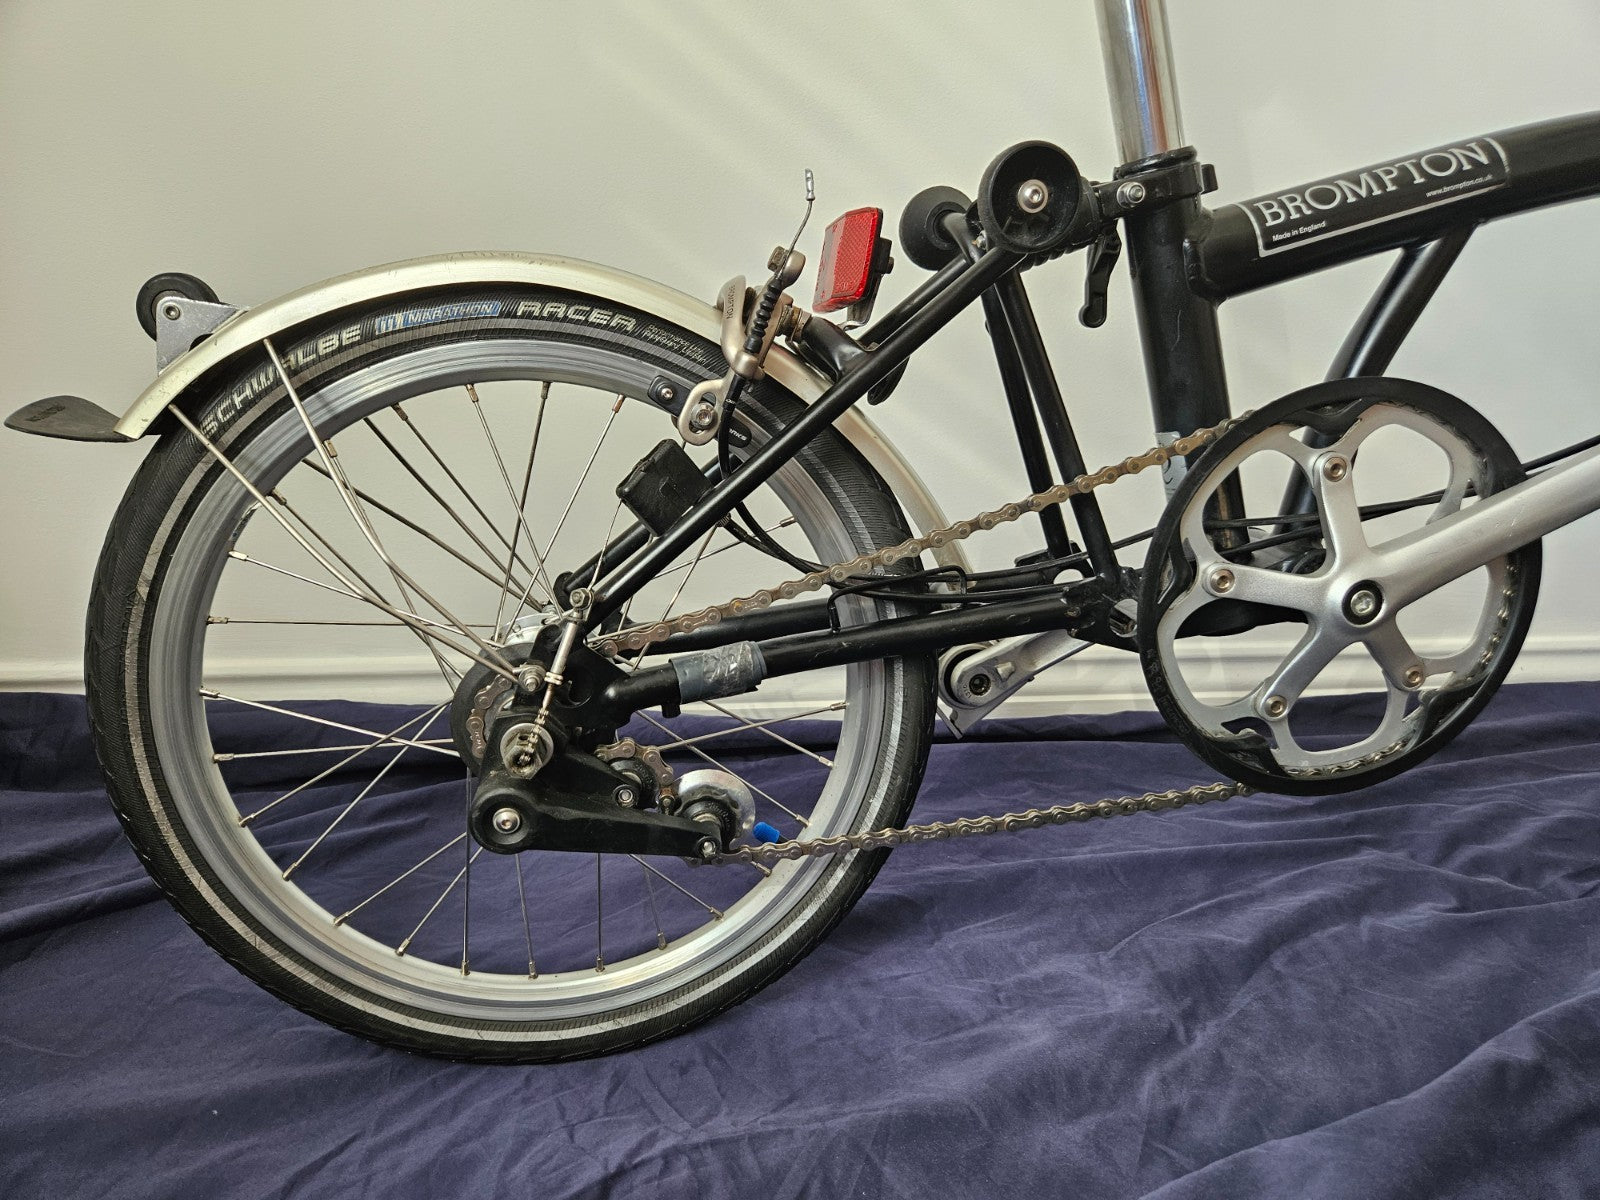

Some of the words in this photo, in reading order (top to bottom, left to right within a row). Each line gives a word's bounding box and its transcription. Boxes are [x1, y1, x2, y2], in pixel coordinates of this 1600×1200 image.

[1254, 141, 1490, 227] BROMPTON
[1272, 232, 1291, 242] Made
[1299, 220, 1326, 234] England
[516, 301, 637, 331] RACER
